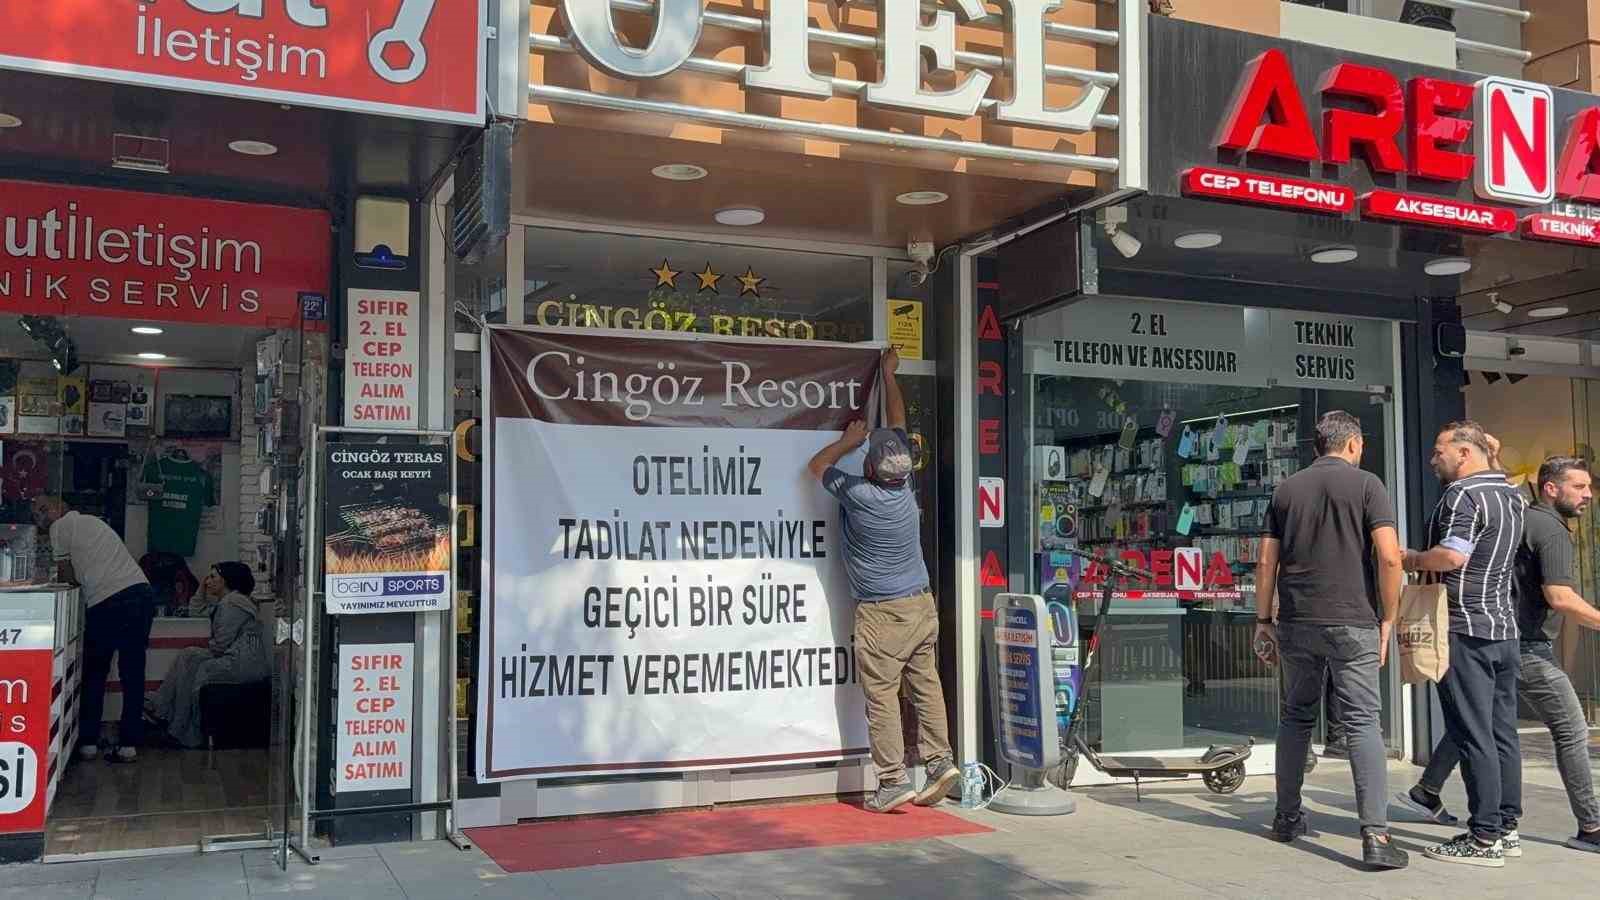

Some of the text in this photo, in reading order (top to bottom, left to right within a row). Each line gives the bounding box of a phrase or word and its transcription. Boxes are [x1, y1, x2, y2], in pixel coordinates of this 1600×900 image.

[136, 4, 326, 81] İletişim
[1200, 172, 1346, 207] CEP TELEFONU
[1394, 197, 1495, 225] AKSESUAR
[1539, 219, 1595, 237] TEKNİK
[89, 277, 261, 313] SERVİS
[358, 300, 408, 316] SIFIR
[536, 294, 698, 333] CİNGÖZ
[360, 320, 407, 336] 2. EL
[1131, 312, 1167, 336] 2. EL
[1294, 320, 1354, 347] TEKNİK
[363, 341, 402, 356] CEP
[1054, 340, 1237, 373] TELEFON VE AKSESUAR
[352, 362, 413, 378] TELEFON
[1295, 353, 1355, 381] SERVİS
[361, 383, 404, 399] ALIM
[526, 351, 862, 420] Cingöz Resort
[353, 404, 411, 421] SATIMI
[331, 450, 443, 464] CİNGÖZ TERAS
[342, 471, 372, 479] OCAK
[375, 471, 398, 481] BAŞI
[632, 445, 763, 497] OTELİMİZ
[558, 509, 826, 561] TADİLAT NEDENİYLE
[388, 578, 440, 592] SPORTS
[340, 599, 437, 610] YAYINIMIZ MEVCUTTUR
[584, 572, 808, 639] GEÇİCİ BİR SÜRE
[351, 655, 402, 670] SIFIR
[501, 634, 862, 698] HİZMET VEREMEMEKTEDİ
[353, 675, 401, 692] 2. EL
[356, 698, 396, 713] CEP
[345, 718, 405, 736] TELEFON
[352, 740, 396, 757] ALIM
[345, 762, 403, 780] SATIMI
